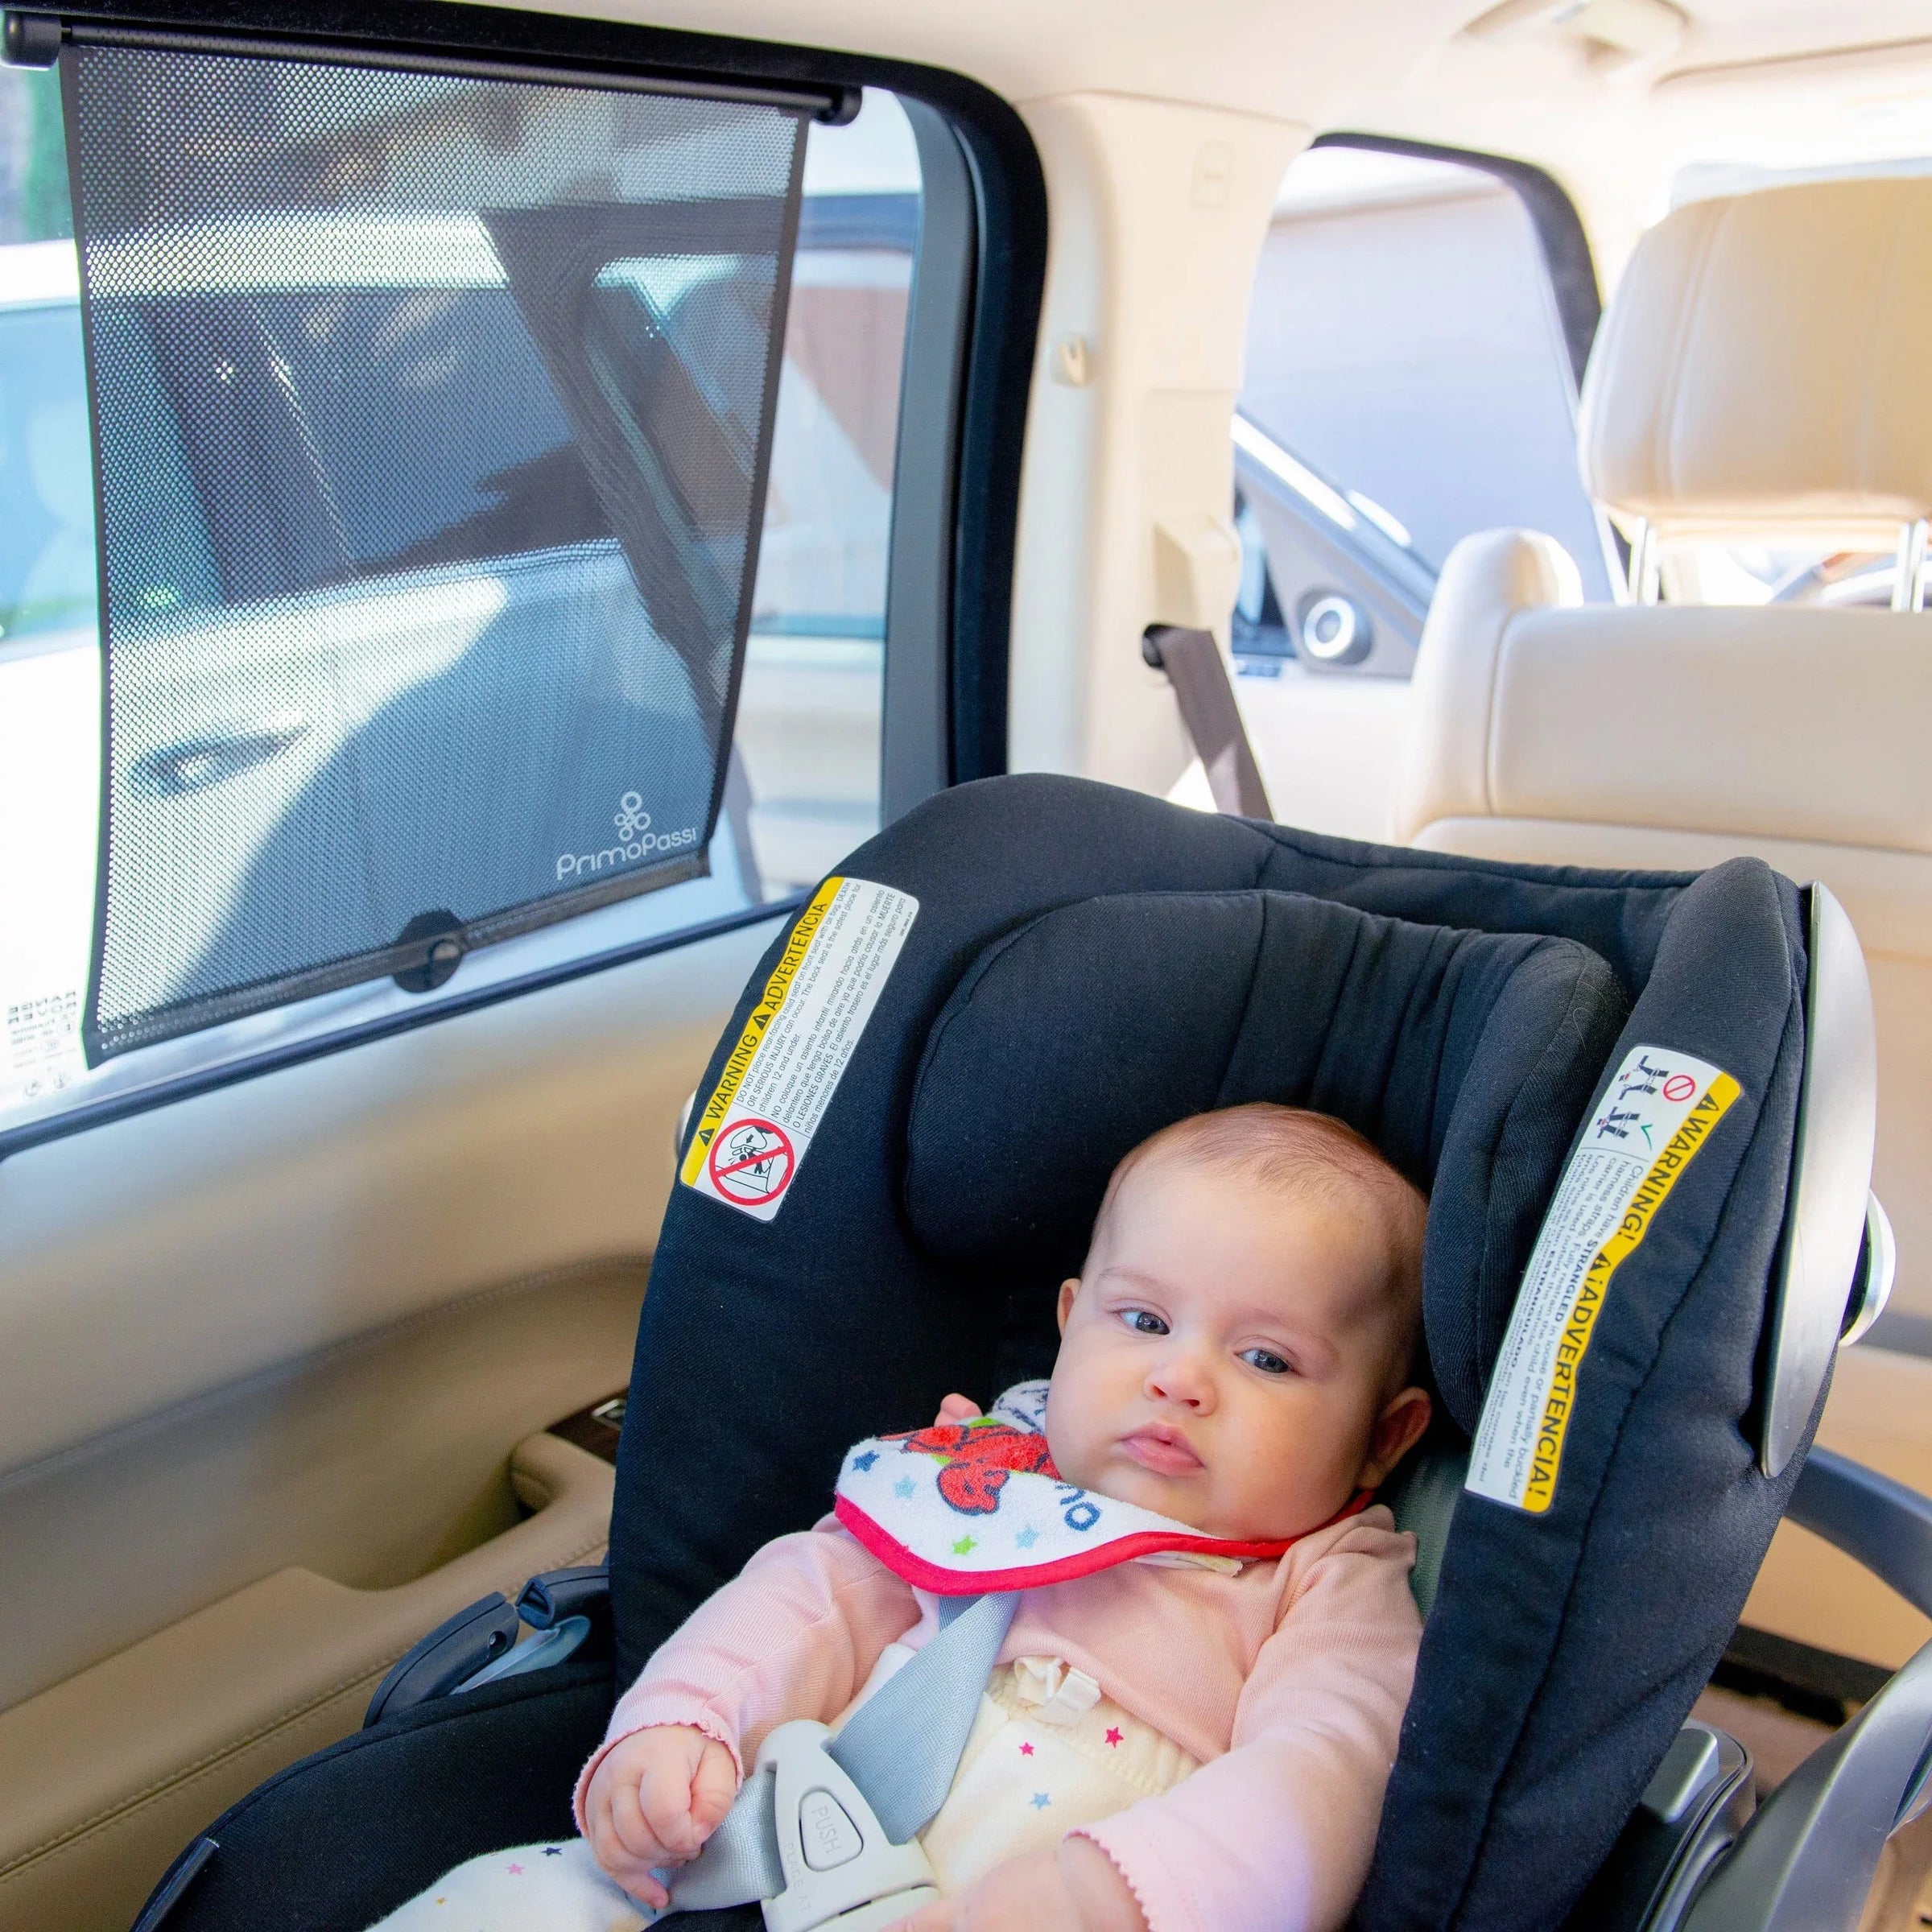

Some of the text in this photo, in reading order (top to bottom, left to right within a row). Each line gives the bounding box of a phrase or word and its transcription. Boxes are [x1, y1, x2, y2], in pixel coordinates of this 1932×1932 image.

[868, 889, 885, 913] asiento
[894, 898, 906, 913] para
[859, 926, 867, 935] en
[864, 914, 873, 924] un
[884, 914, 900, 937] seguro
[839, 955, 854, 975] hacia
[863, 972, 871, 980] el
[867, 953, 881, 972] lugar
[737, 1089, 747, 1102] DO
[743, 1072, 755, 1089] NOT
[751, 1051, 766, 1073] place
[762, 1013, 786, 1052] rear-facing
[781, 997, 795, 1014] child
[790, 981, 801, 997] seat
[798, 971, 806, 980] on
[803, 954, 814, 971] front
[811, 939, 821, 954] seat
[836, 881, 850, 902] DEATH
[746, 1095, 758, 1107] OR
[753, 1061, 774, 1094] SERIOUS
[770, 1034, 786, 1060] INJURY
[784, 1019, 795, 1033] can
[792, 997, 806, 1018] occur.
[801, 982, 812, 997] The
[808, 964, 821, 981] back
[818, 949, 828, 964] seat
[828, 930, 837, 942] the
[833, 910, 847, 930] safest
[843, 892, 857, 910] place
[852, 883, 861, 892] for
[825, 976, 844, 1005] mirando
[860, 980, 868, 989] es
[706, 901, 828, 1121] WARNING ADVERTENCIA
[781, 1088, 803, 1123] delantero
[800, 1072, 811, 1088] que
[807, 1050, 823, 1071] tenga
[817, 1029, 832, 1049] bolsa
[828, 1017, 837, 1027] de
[833, 1002, 844, 1016] aire
[841, 992, 850, 1001] ya
[846, 976, 858, 992] que
[864, 929, 879, 952] causar
[877, 892, 895, 920] MUERTE
[847, 989, 863, 1014] trasero
[812, 1006, 829, 1031] infantil
[833, 1015, 851, 1042] asiento
[799, 1032, 817, 1060] asiento
[758, 1032, 800, 1112] children 12 and under.
[795, 1061, 803, 1071] un
[814, 1051, 834, 1083] GRAVES.
[778, 1073, 799, 1104] coloque
[803, 1037, 854, 1133] niños menores de 12 años.
[770, 1104, 782, 1117] NO
[796, 1083, 819, 1120] LESIONES
[1593, 1157, 1617, 1190] carrier
[1599, 1160, 1630, 1203] harness
[1617, 1116, 1708, 1241] WARNING!
[1610, 1165, 1644, 1212] Children
[1594, 1214, 1616, 1237] have
[1563, 1243, 1580, 1269] Fully
[1554, 1239, 1598, 1323] STRANGLED
[1527, 1343, 1541, 1373] child
[1538, 1340, 1553, 1374] loose
[1534, 1377, 1543, 1391] or
[1519, 1393, 1539, 1444] partially
[1508, 1447, 1530, 1499] buckled
[811, 1805, 842, 1854] PUSH
